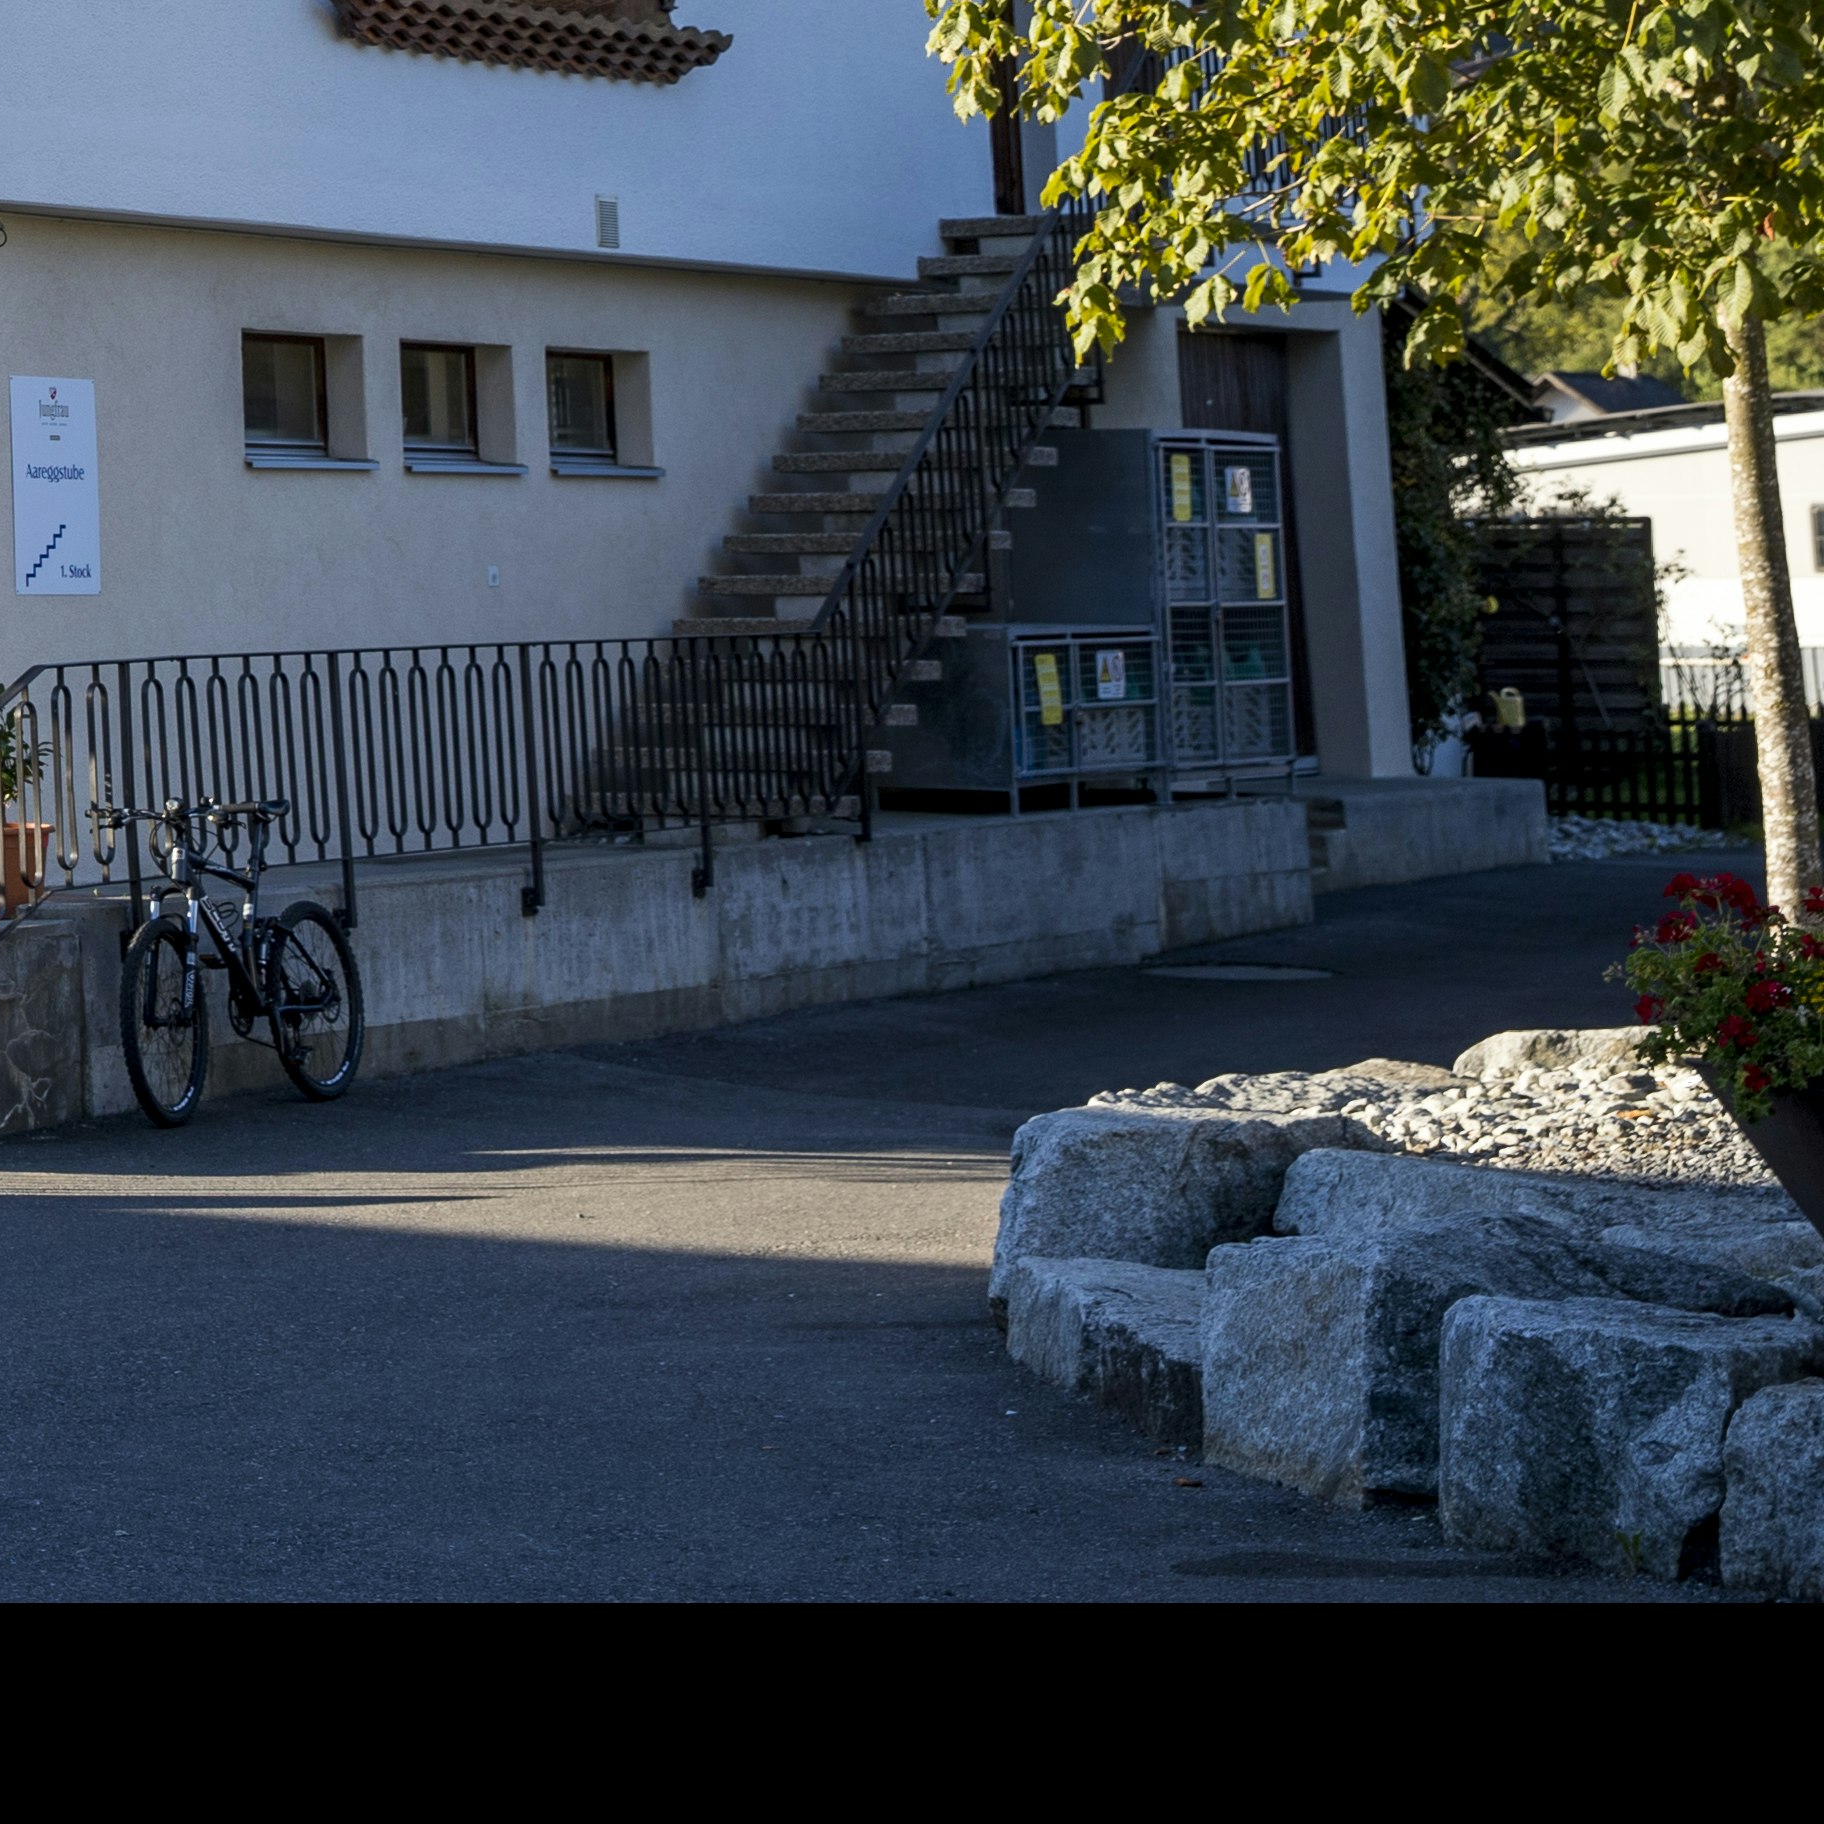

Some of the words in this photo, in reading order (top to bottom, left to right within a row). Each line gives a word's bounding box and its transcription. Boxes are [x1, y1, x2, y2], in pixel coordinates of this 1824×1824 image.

[38, 399, 70, 421] Jungfrau
[26, 463, 85, 483] Aareggstube
[60, 564, 68, 578] 1.
[68, 563, 92, 578] Stock
